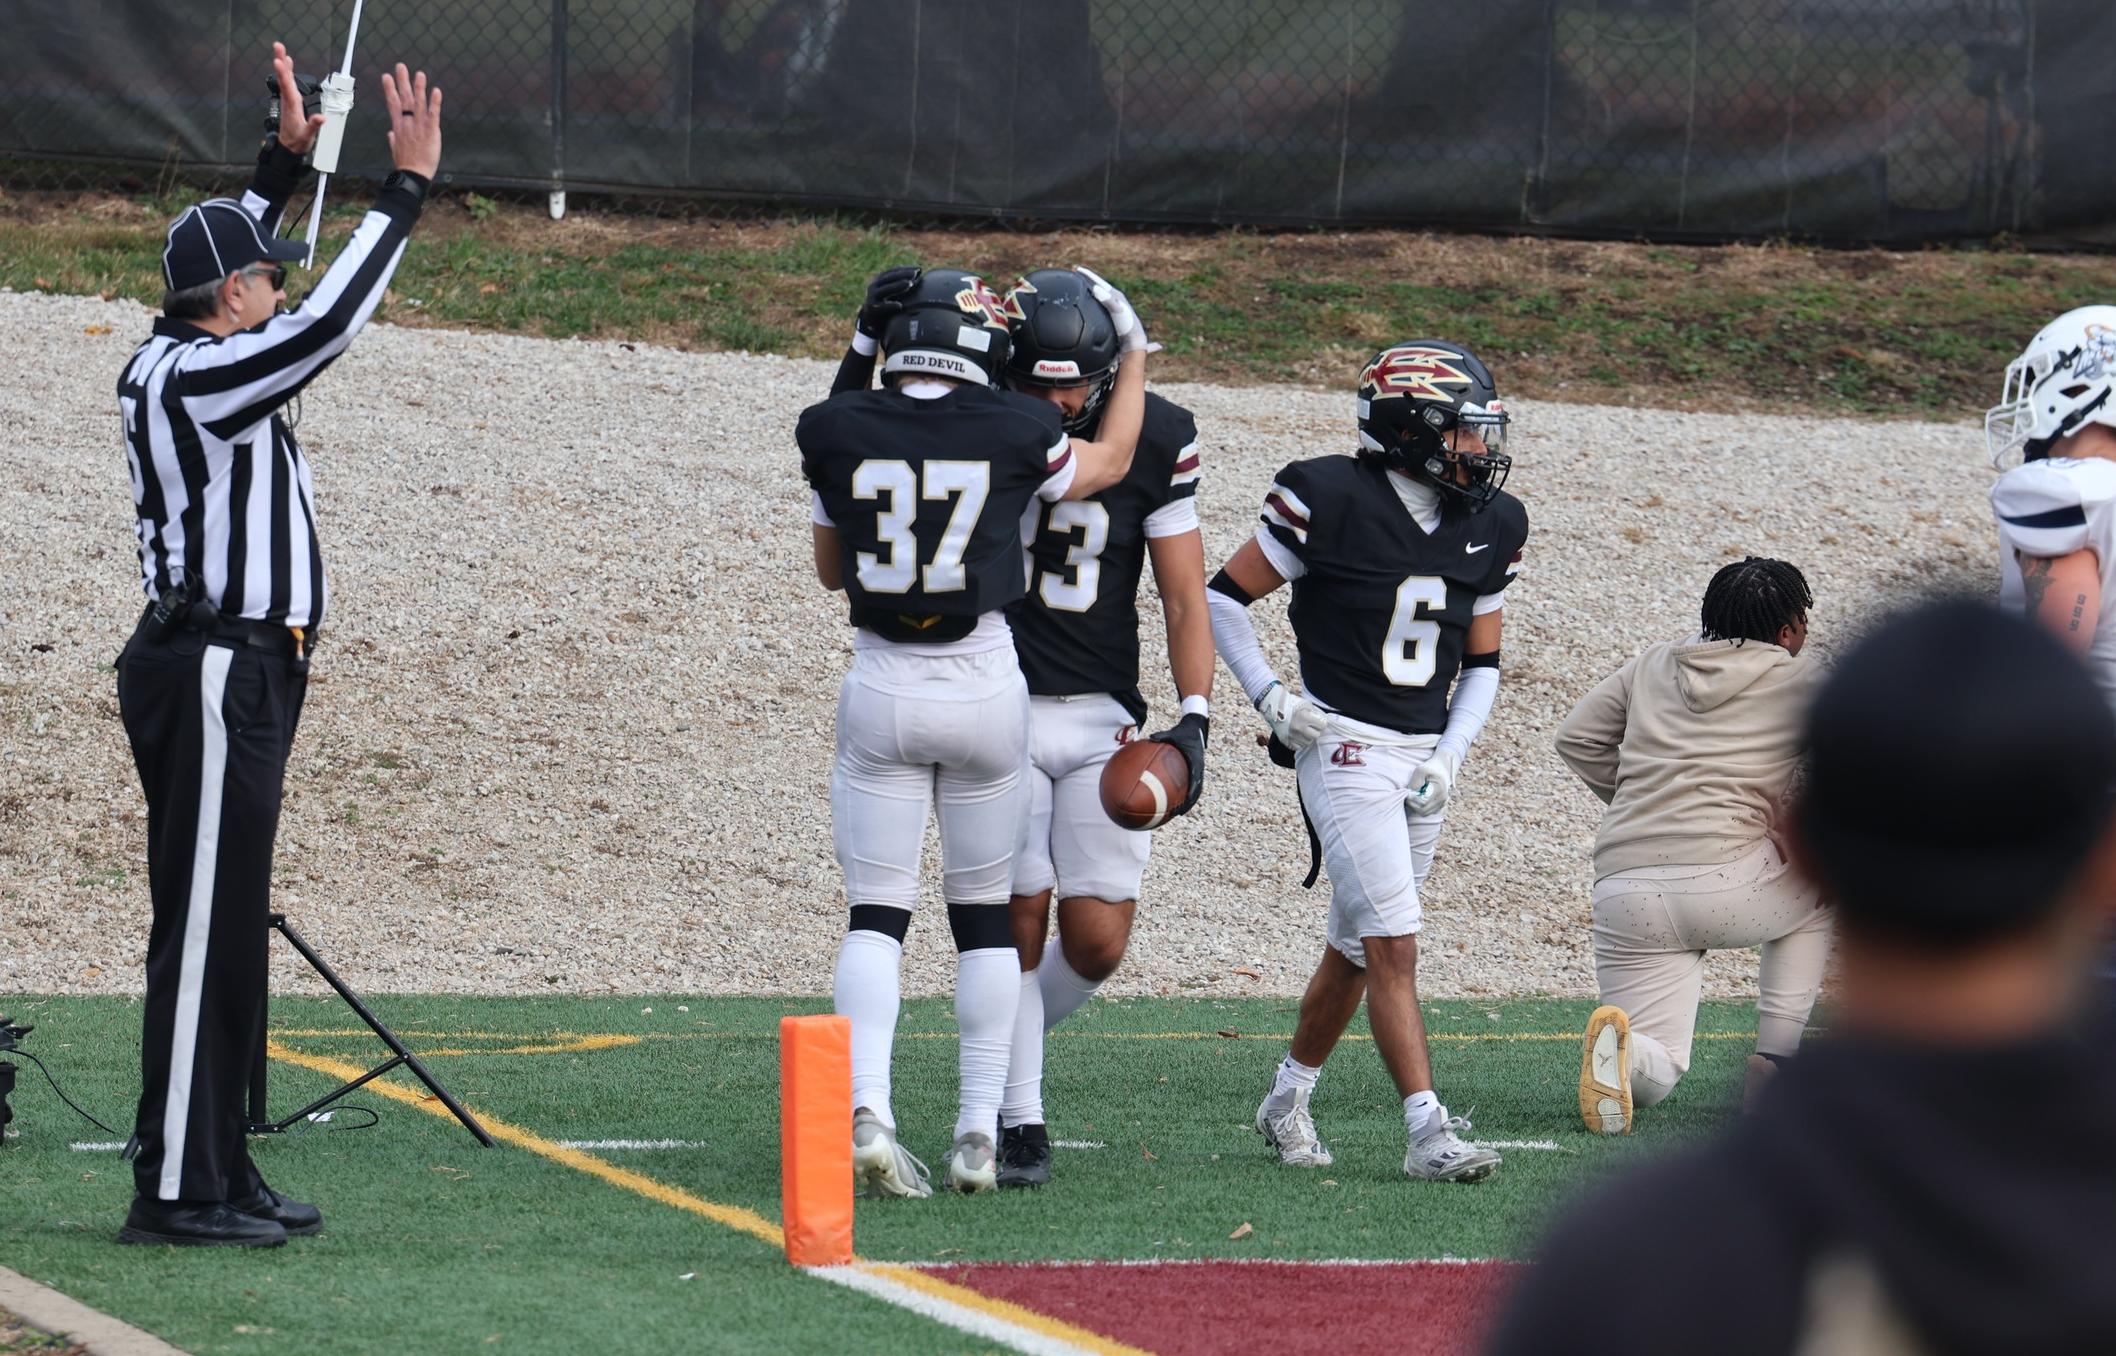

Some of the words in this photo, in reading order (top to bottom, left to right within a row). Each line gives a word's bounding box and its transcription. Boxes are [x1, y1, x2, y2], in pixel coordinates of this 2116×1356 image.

[902, 355, 926, 366] RED
[928, 357, 965, 373] DEVIL
[852, 459, 991, 594] 37
[1382, 575, 1447, 687] 6
